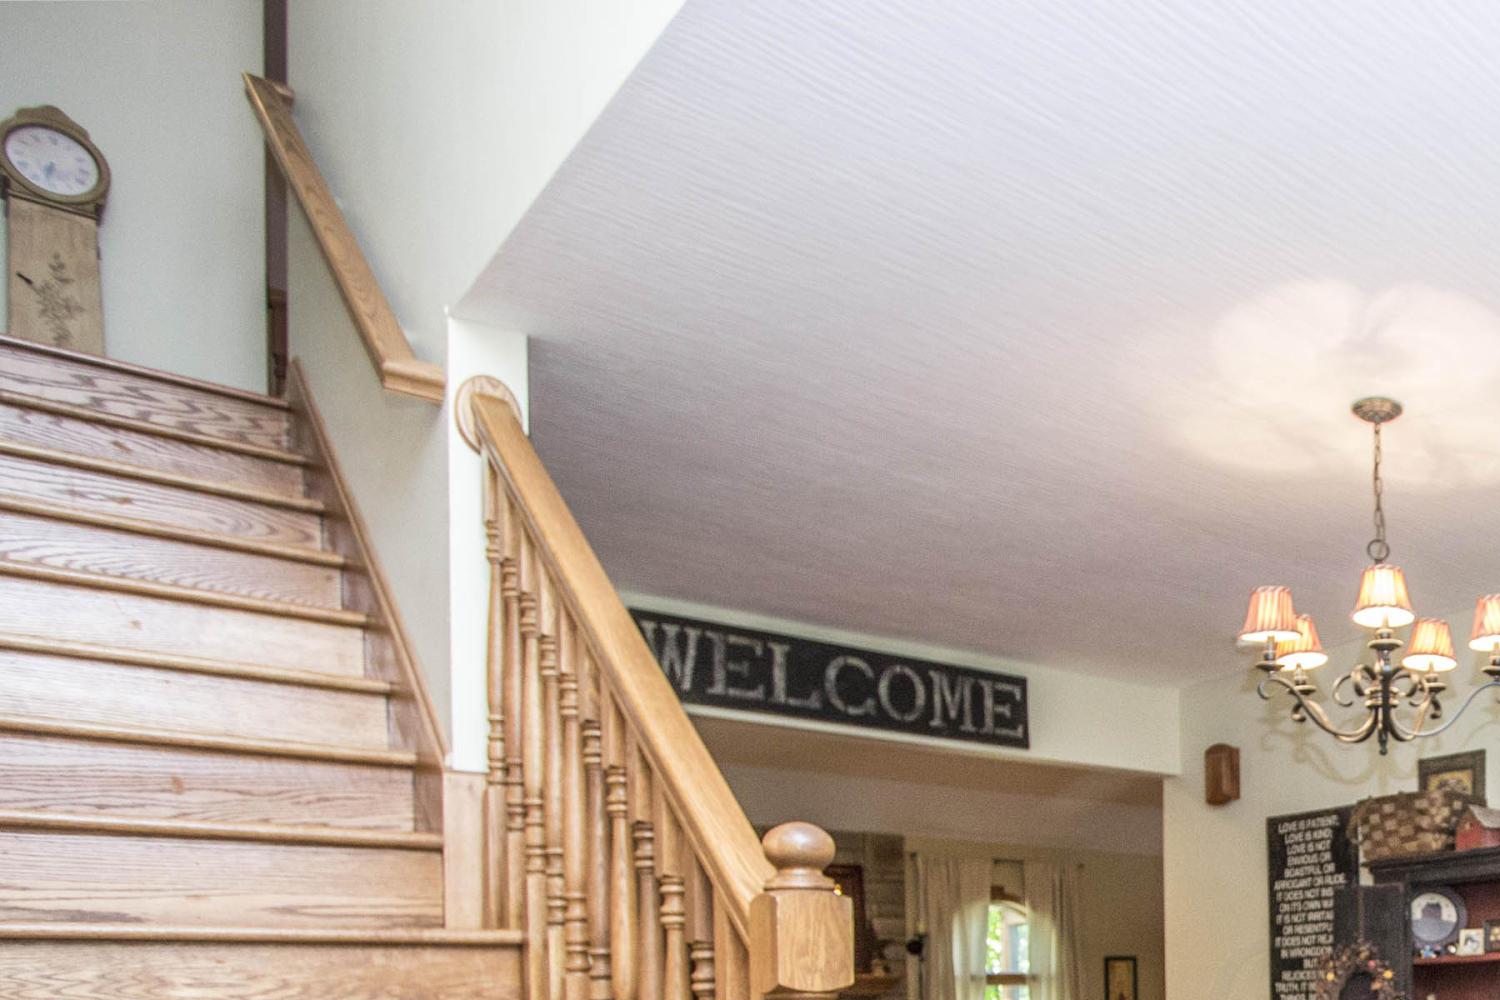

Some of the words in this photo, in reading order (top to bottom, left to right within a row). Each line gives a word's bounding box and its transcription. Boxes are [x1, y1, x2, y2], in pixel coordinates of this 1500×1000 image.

[641, 619, 1024, 739] WELCOME
[1278, 821, 1297, 833] LOVE
[1285, 831, 1304, 845] LOVE
[1287, 842, 1306, 855] LOVE
[1315, 839, 1331, 851] NOT
[1320, 851, 1332, 863] OR
[1323, 862, 1336, 874] OR
[1313, 875, 1324, 887] OR
[1283, 889, 1304, 901] DOES
[1305, 887, 1320, 899] NOT
[1282, 935, 1301, 947] DOES
[1302, 933, 1317, 945] NOT
